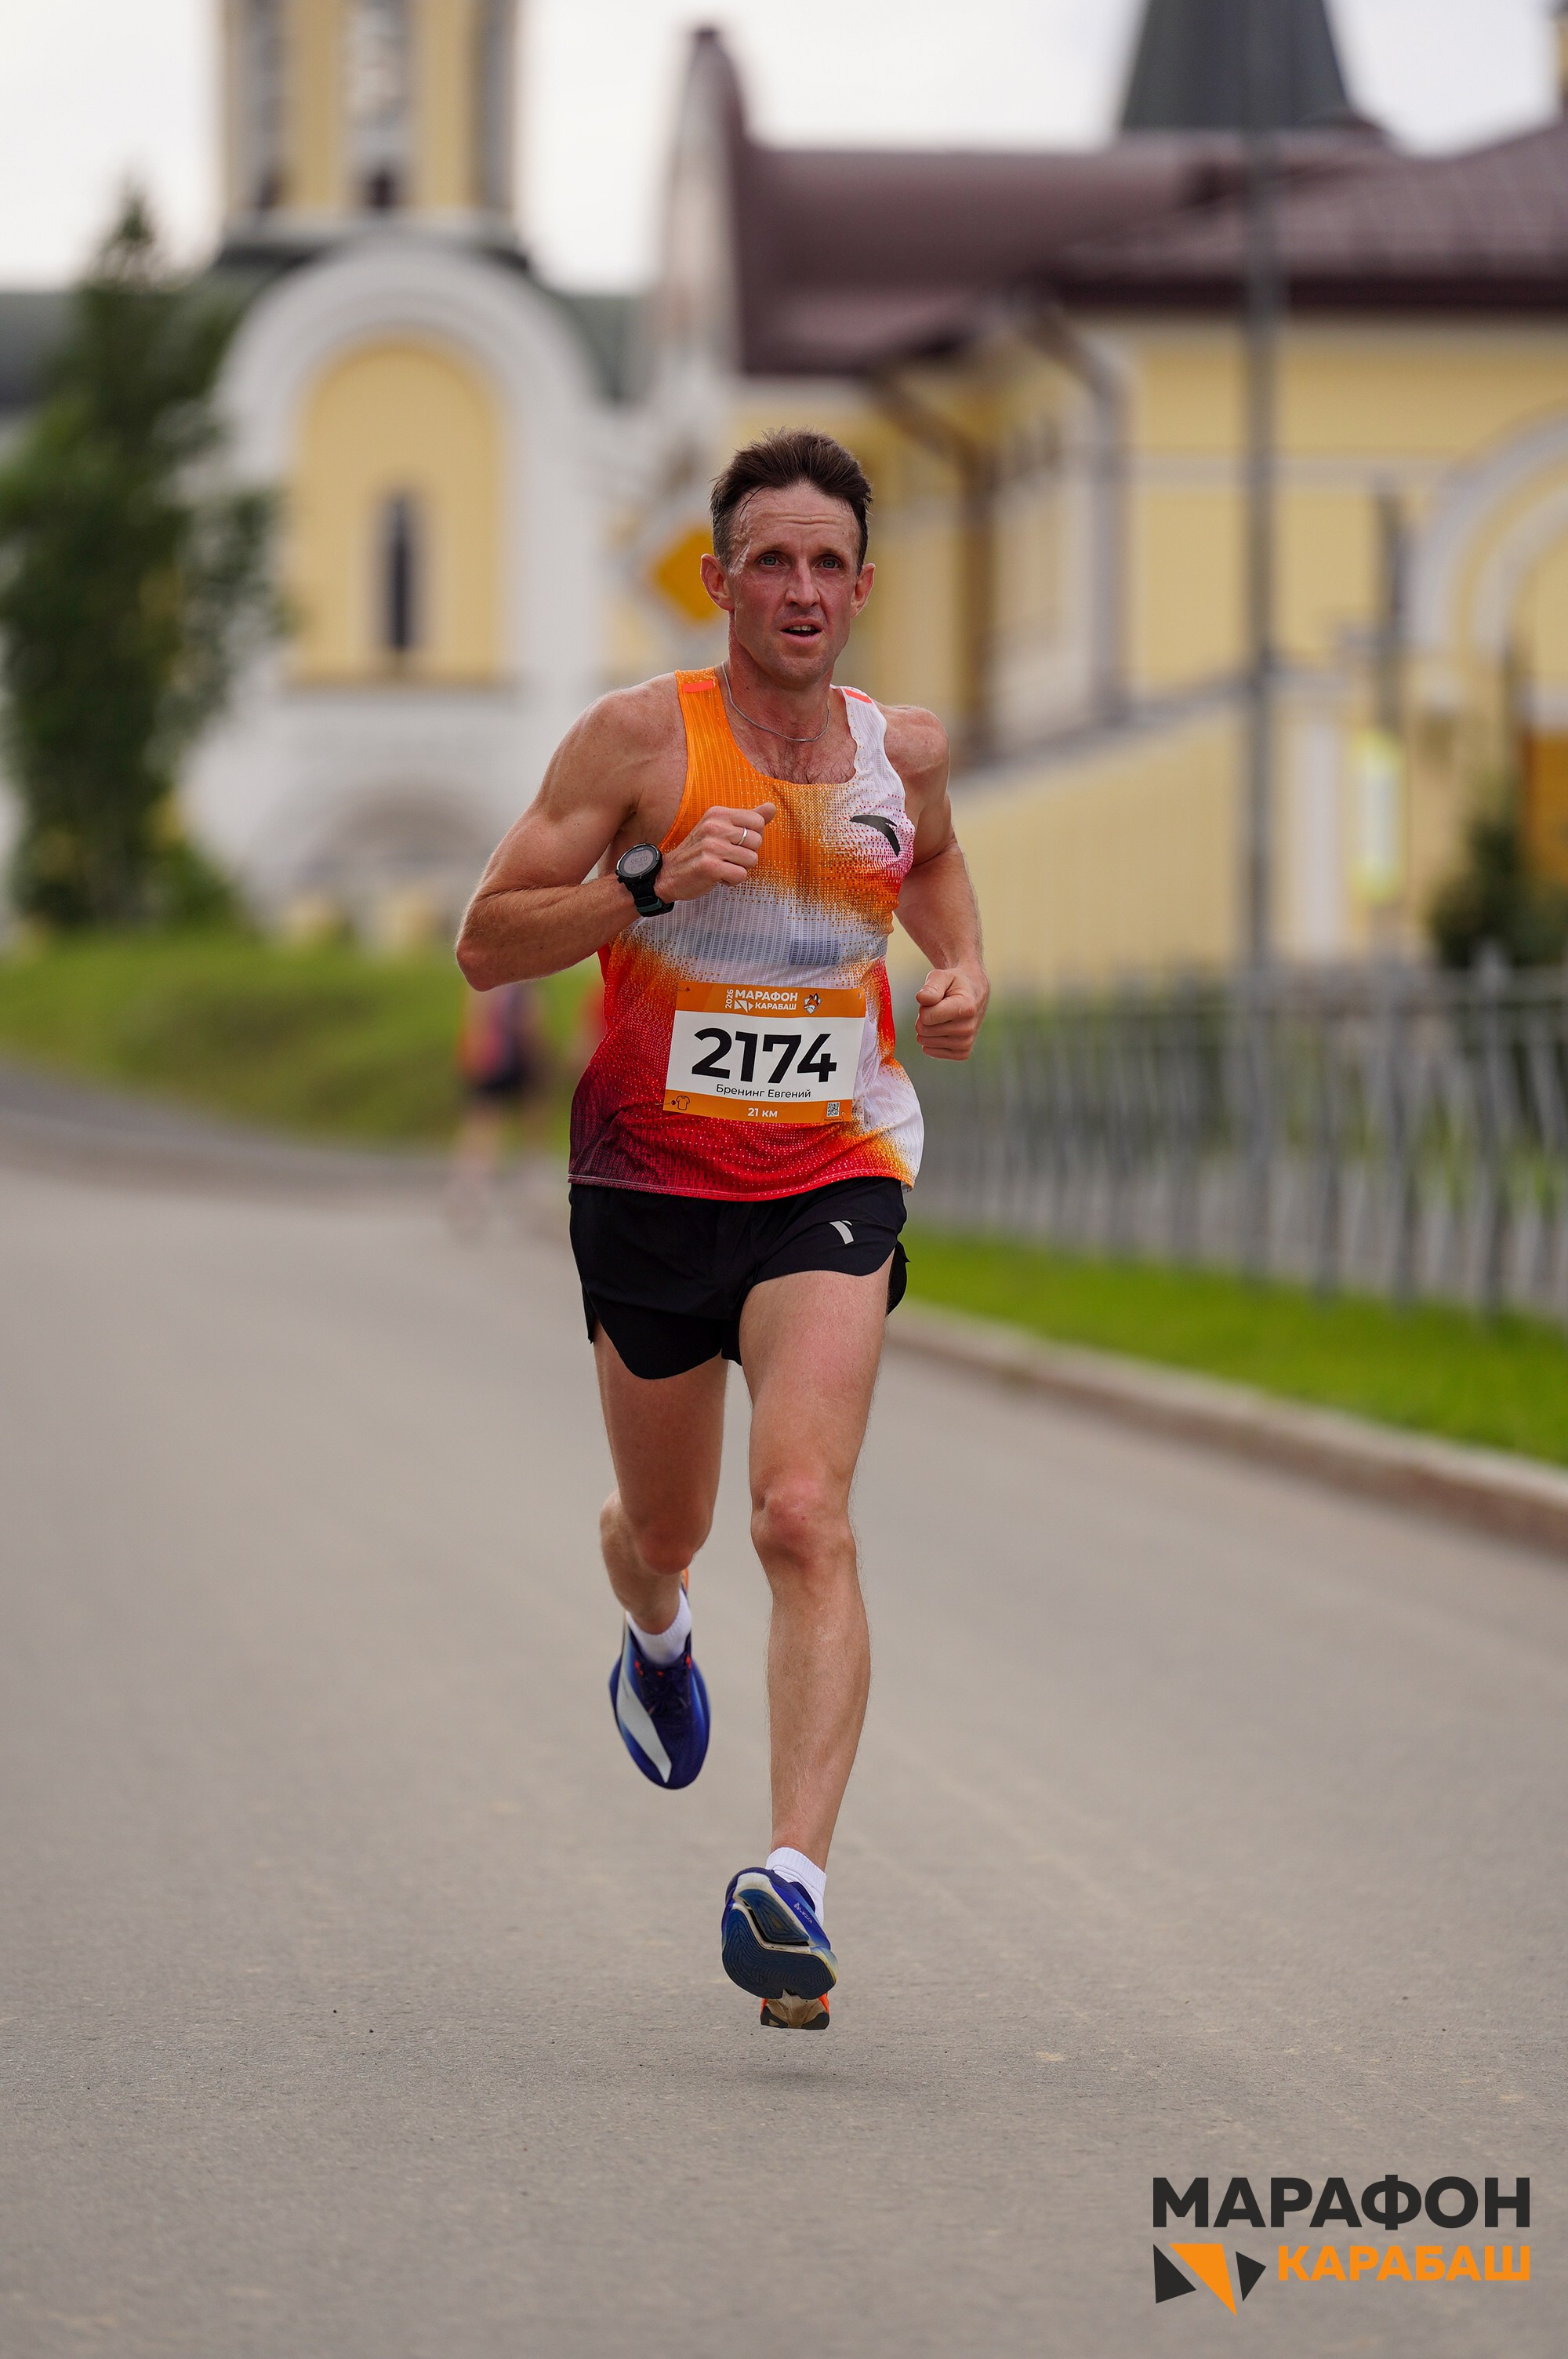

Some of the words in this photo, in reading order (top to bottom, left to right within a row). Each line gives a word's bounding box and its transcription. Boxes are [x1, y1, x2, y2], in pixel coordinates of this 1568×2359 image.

[724, 989, 734, 1009] 2026
[735, 989, 798, 1002] МАРАФОН
[755, 1001, 797, 1010] КАРАБАШ
[691, 1027, 837, 1084] 2174
[716, 1084, 764, 1097] Бренинг
[768, 1089, 811, 1098] Евгений
[747, 1107, 759, 1117] 21
